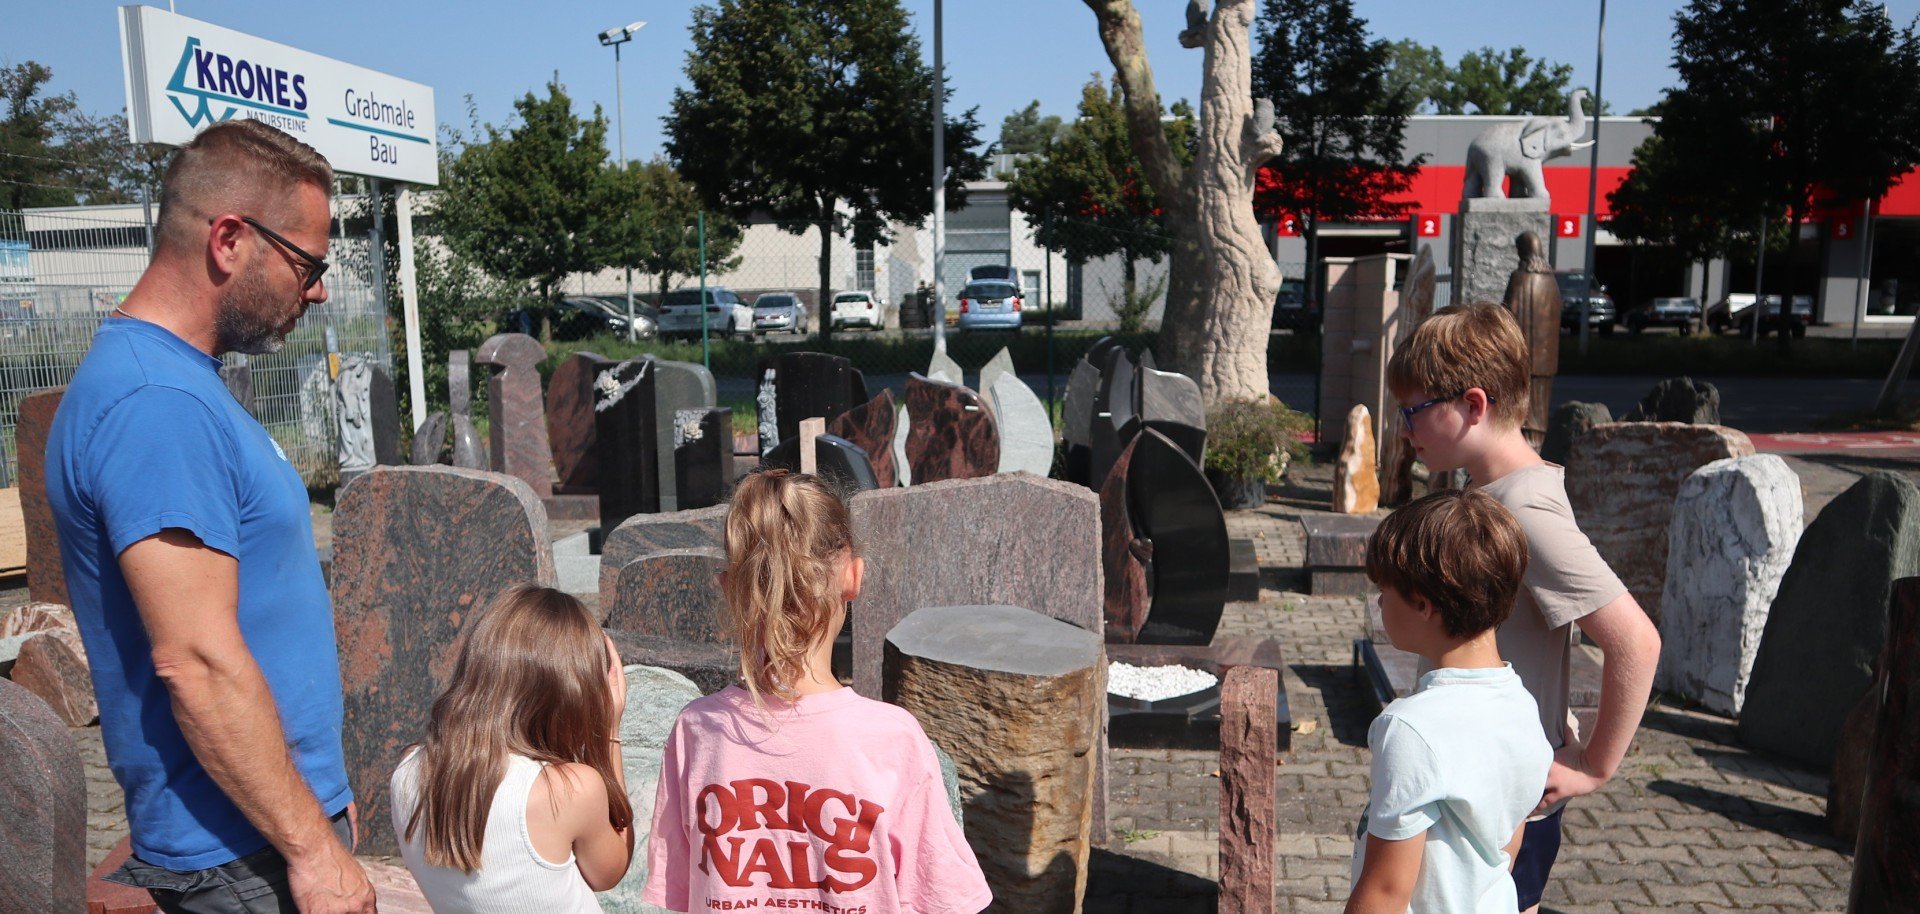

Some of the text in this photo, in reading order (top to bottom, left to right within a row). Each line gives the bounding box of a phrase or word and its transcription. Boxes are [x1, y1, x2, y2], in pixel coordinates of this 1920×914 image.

[194, 48, 308, 111] KRONES
[246, 109, 307, 133] NATURSTEINE
[344, 88, 415, 129] Grabmale
[369, 135, 398, 165] Bau
[1424, 220, 1435, 234] 2
[1564, 220, 1574, 234] 3
[1838, 223, 1847, 236] 5
[696, 778, 885, 853] ORIGI
[697, 835, 878, 895] NALS
[705, 897, 867, 914] URBAN AESTHETICS
